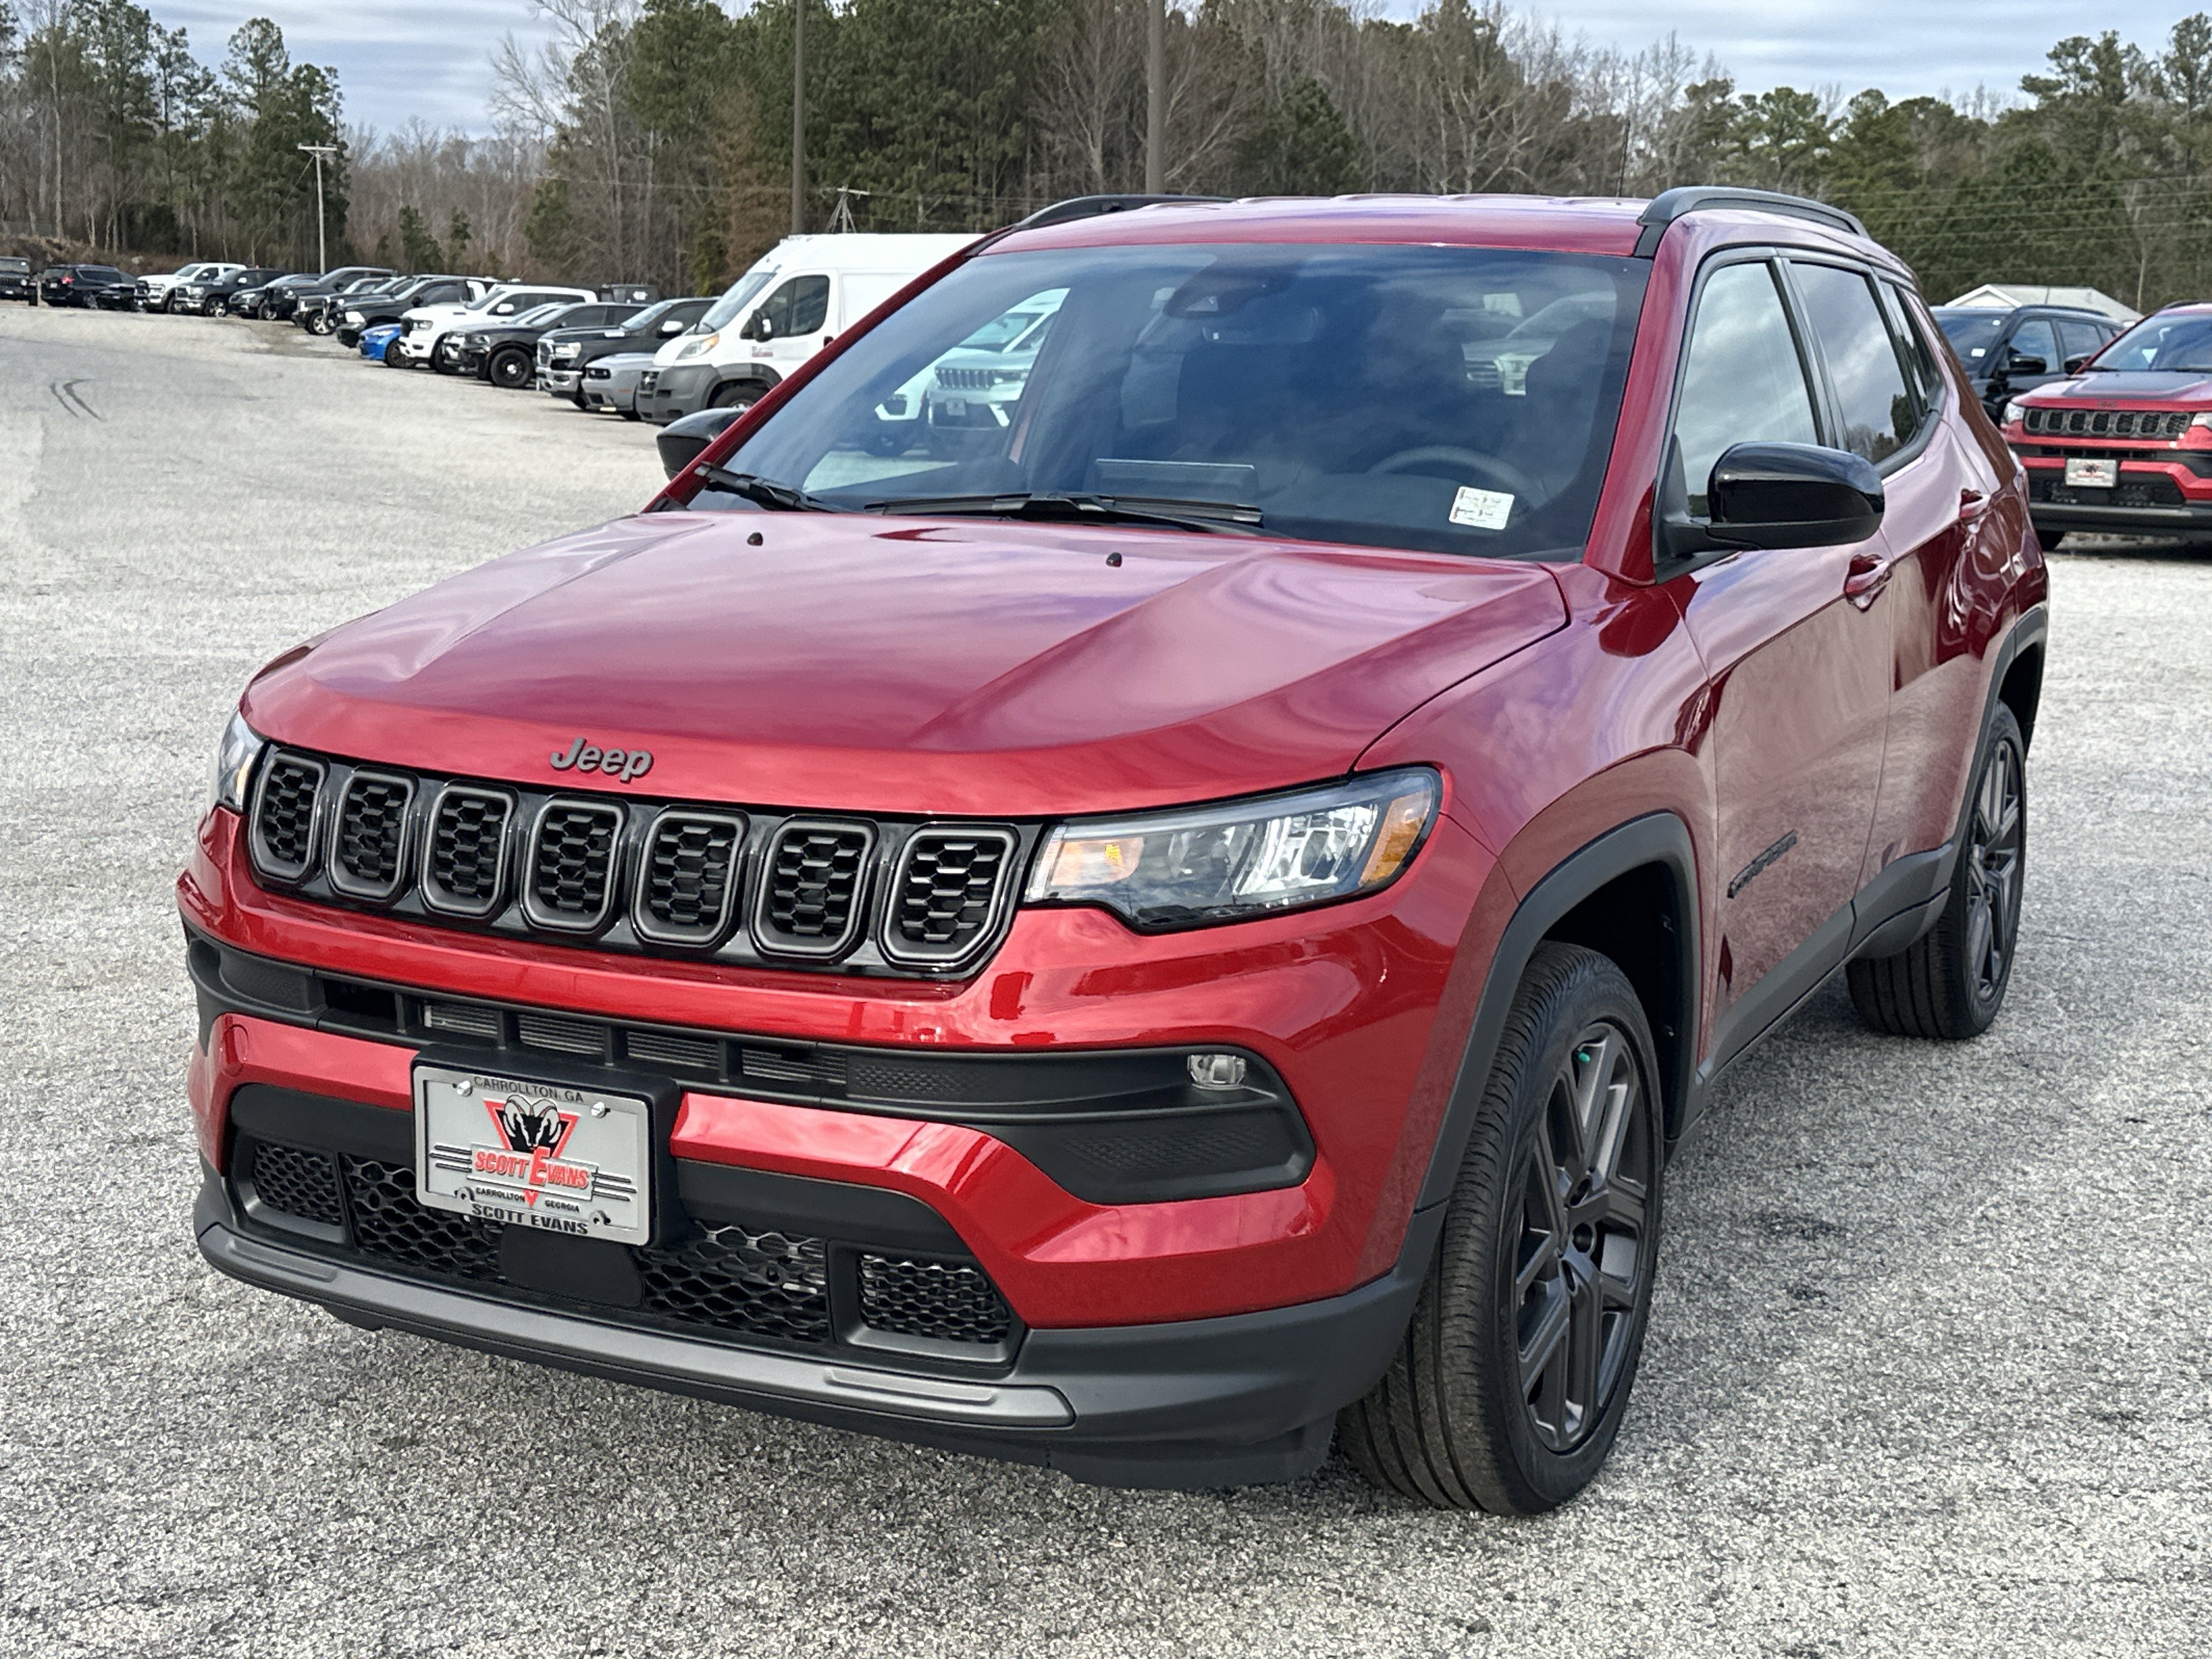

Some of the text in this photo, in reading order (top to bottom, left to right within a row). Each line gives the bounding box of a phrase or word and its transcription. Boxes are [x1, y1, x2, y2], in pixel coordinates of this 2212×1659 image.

[550, 737, 654, 783] Jeep
[564, 1090, 584, 1103] GA
[475, 1147, 590, 1189] SCOTT EVANS
[476, 1187, 579, 1213] CARROLLTON GEORGIA
[472, 1203, 589, 1235] SCOTT EVANS
